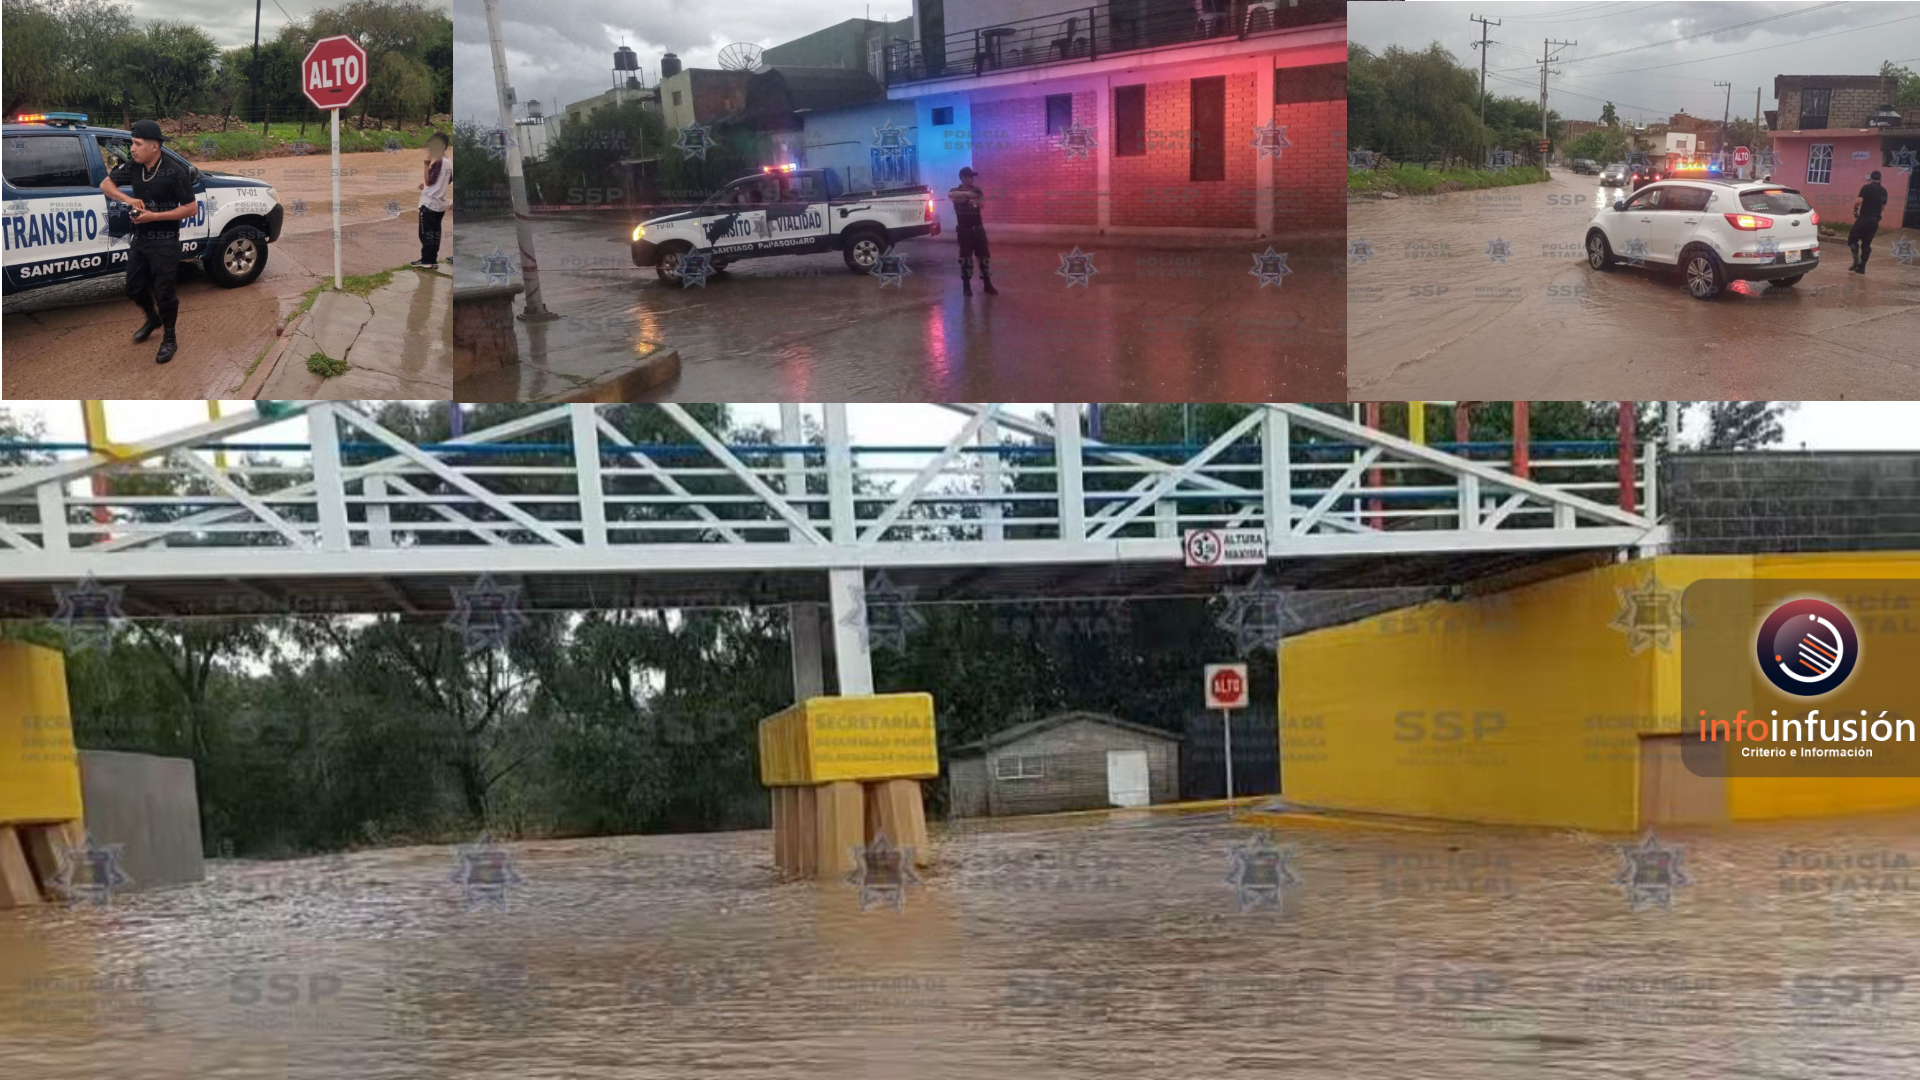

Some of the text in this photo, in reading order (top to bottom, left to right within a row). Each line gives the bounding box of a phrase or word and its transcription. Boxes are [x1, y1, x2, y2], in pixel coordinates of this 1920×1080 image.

[309, 55, 359, 90] ALTO
[1734, 152, 1749, 162] ALTO
[236, 188, 258, 197] TV-01
[2, 208, 98, 250] TRANSITO
[656, 222, 675, 230] TV-01
[776, 211, 822, 232] VIALIDAD
[712, 243, 754, 255] SANTIAGO
[20, 256, 102, 279] SANTIAGO
[1215, 678, 1240, 694] ALTO
